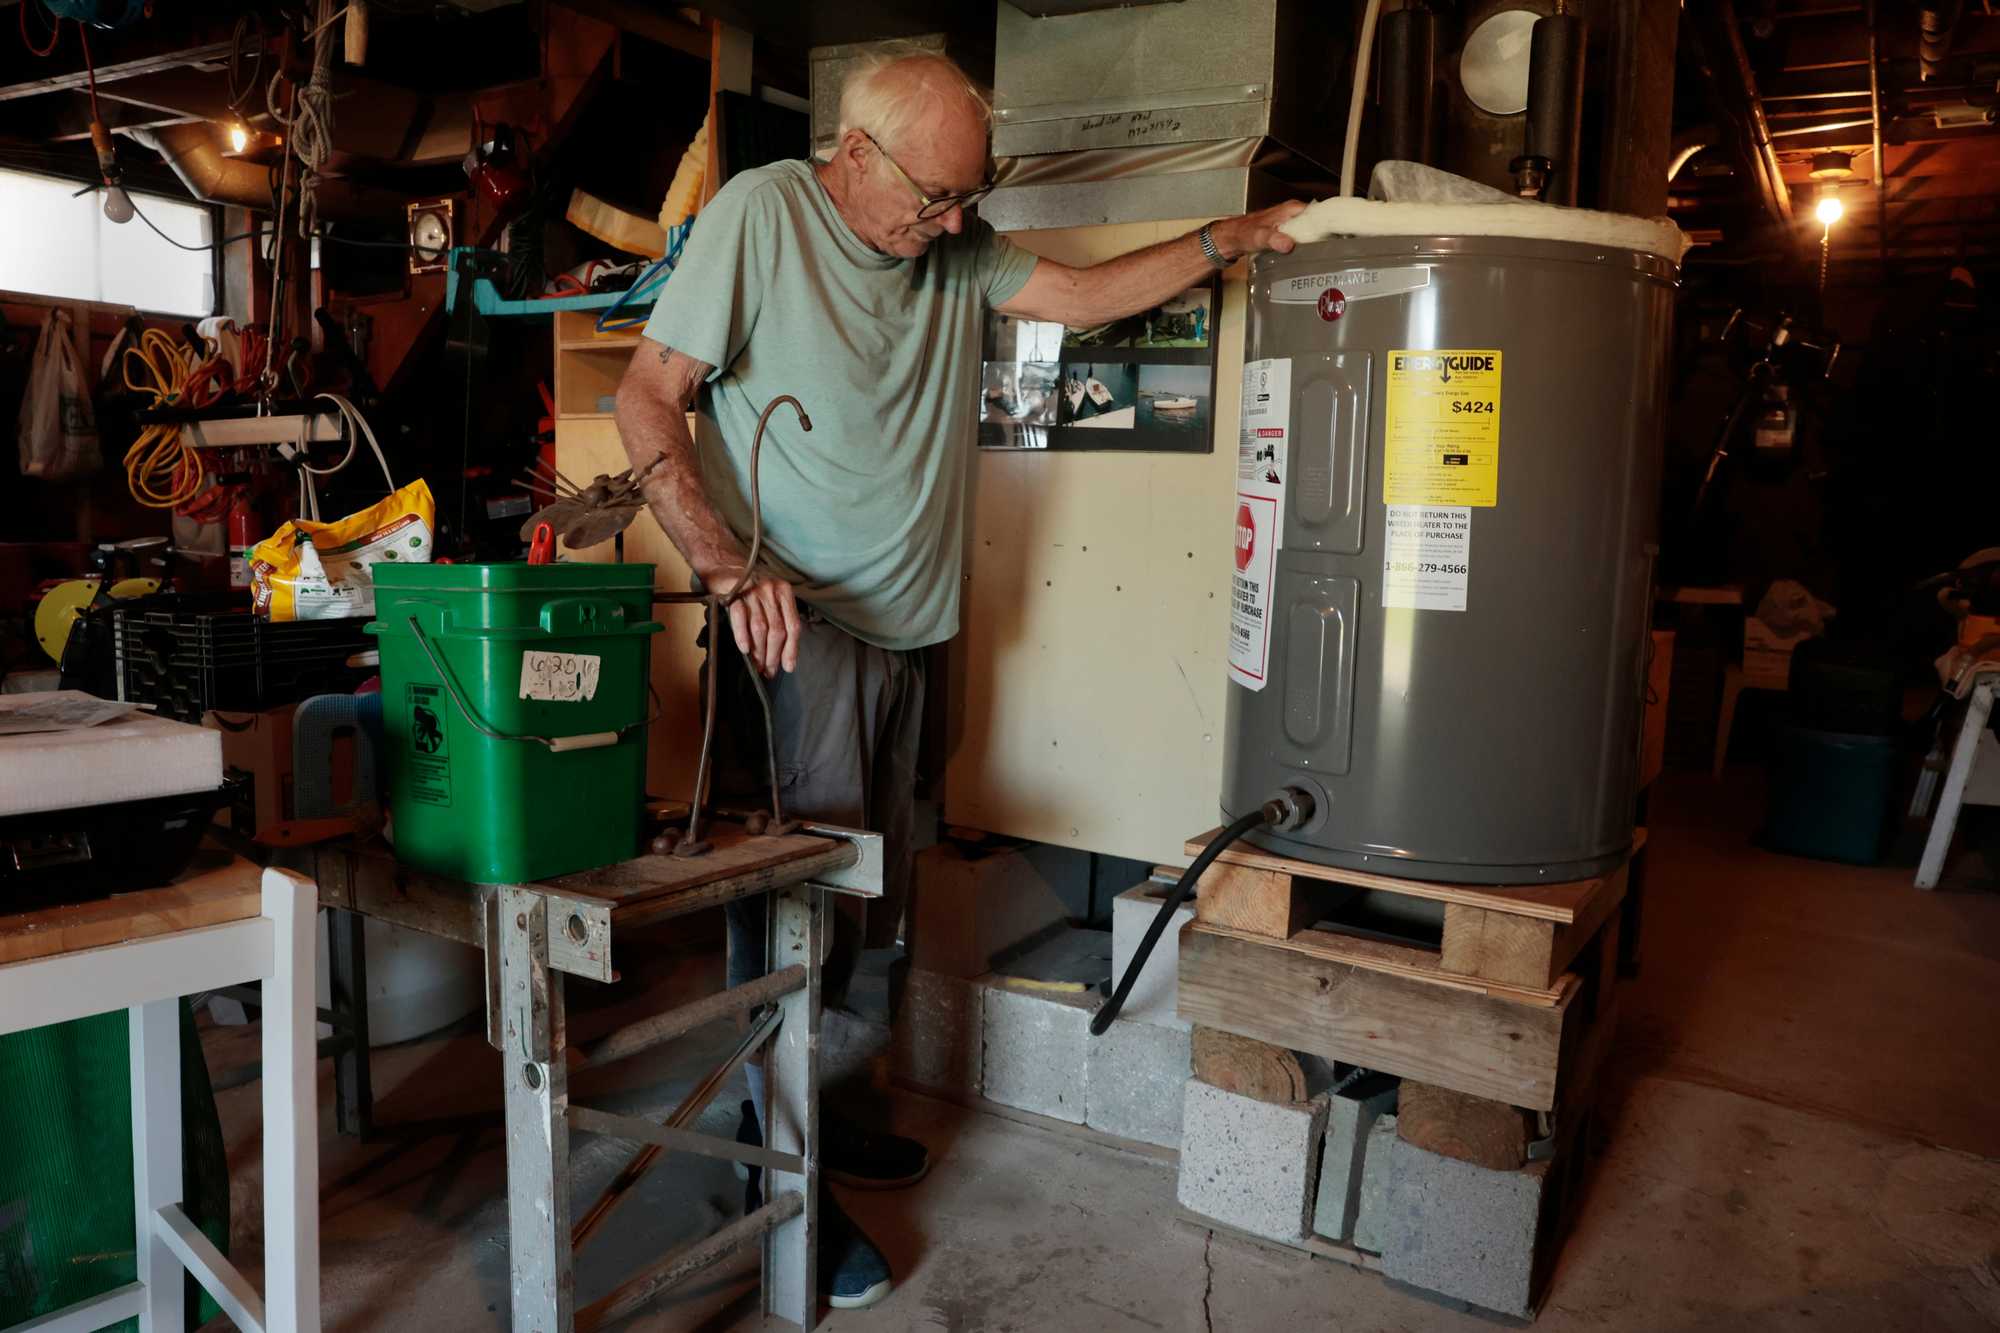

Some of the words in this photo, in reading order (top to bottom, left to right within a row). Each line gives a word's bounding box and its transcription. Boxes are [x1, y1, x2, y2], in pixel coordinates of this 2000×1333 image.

[1290, 271, 1379, 291] PERFORMANCE
[1452, 401, 1494, 414] $424
[1419, 511, 1449, 519] RETURN
[1454, 522, 1468, 530] THE
[1425, 531, 1464, 540] PURCHASE
